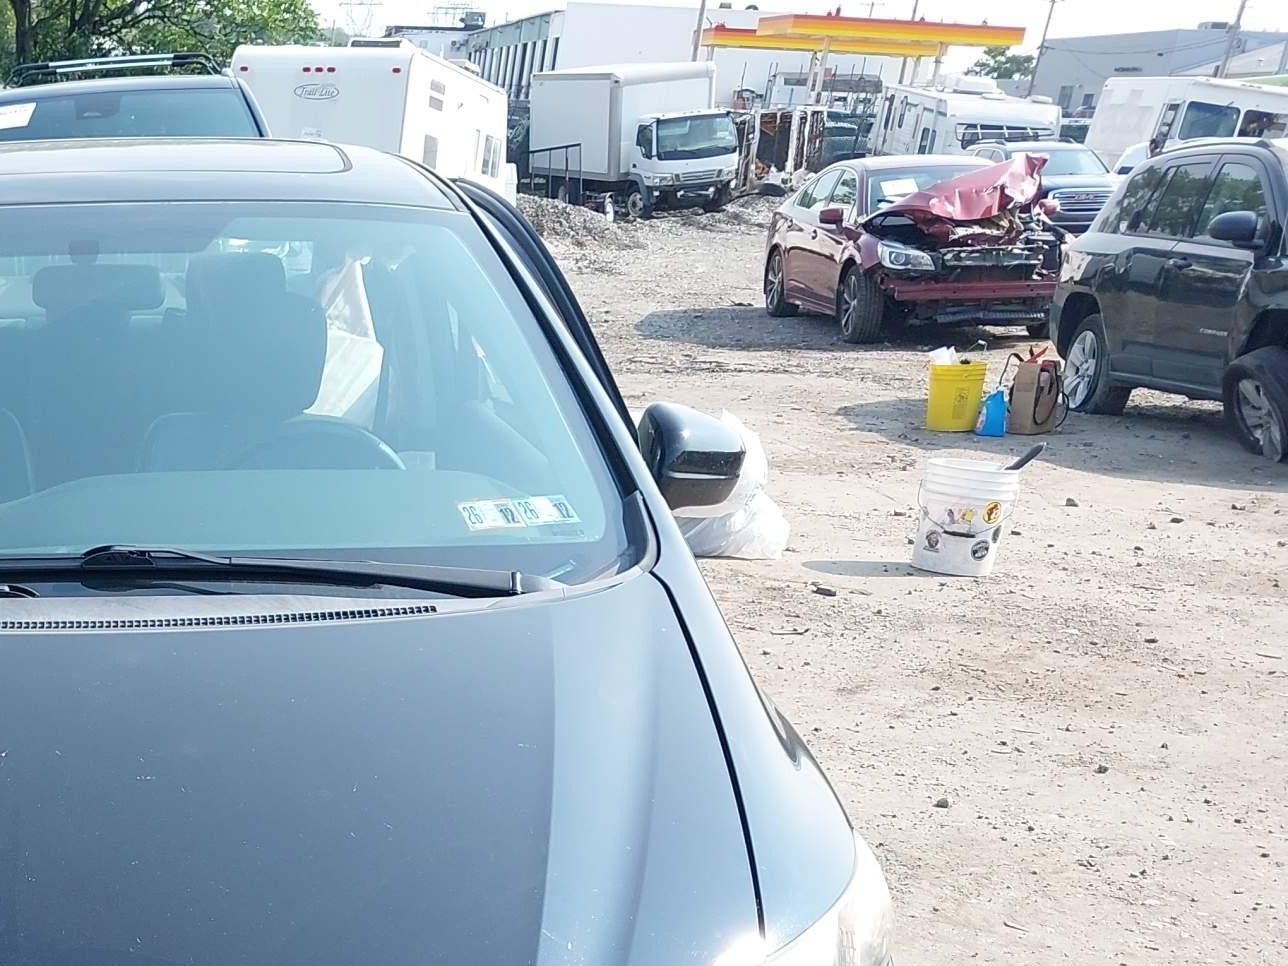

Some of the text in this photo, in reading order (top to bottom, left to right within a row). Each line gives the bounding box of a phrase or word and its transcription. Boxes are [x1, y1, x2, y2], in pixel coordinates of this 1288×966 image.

[462, 505, 520, 524] 26 12
[518, 501, 574, 519] 26 12
